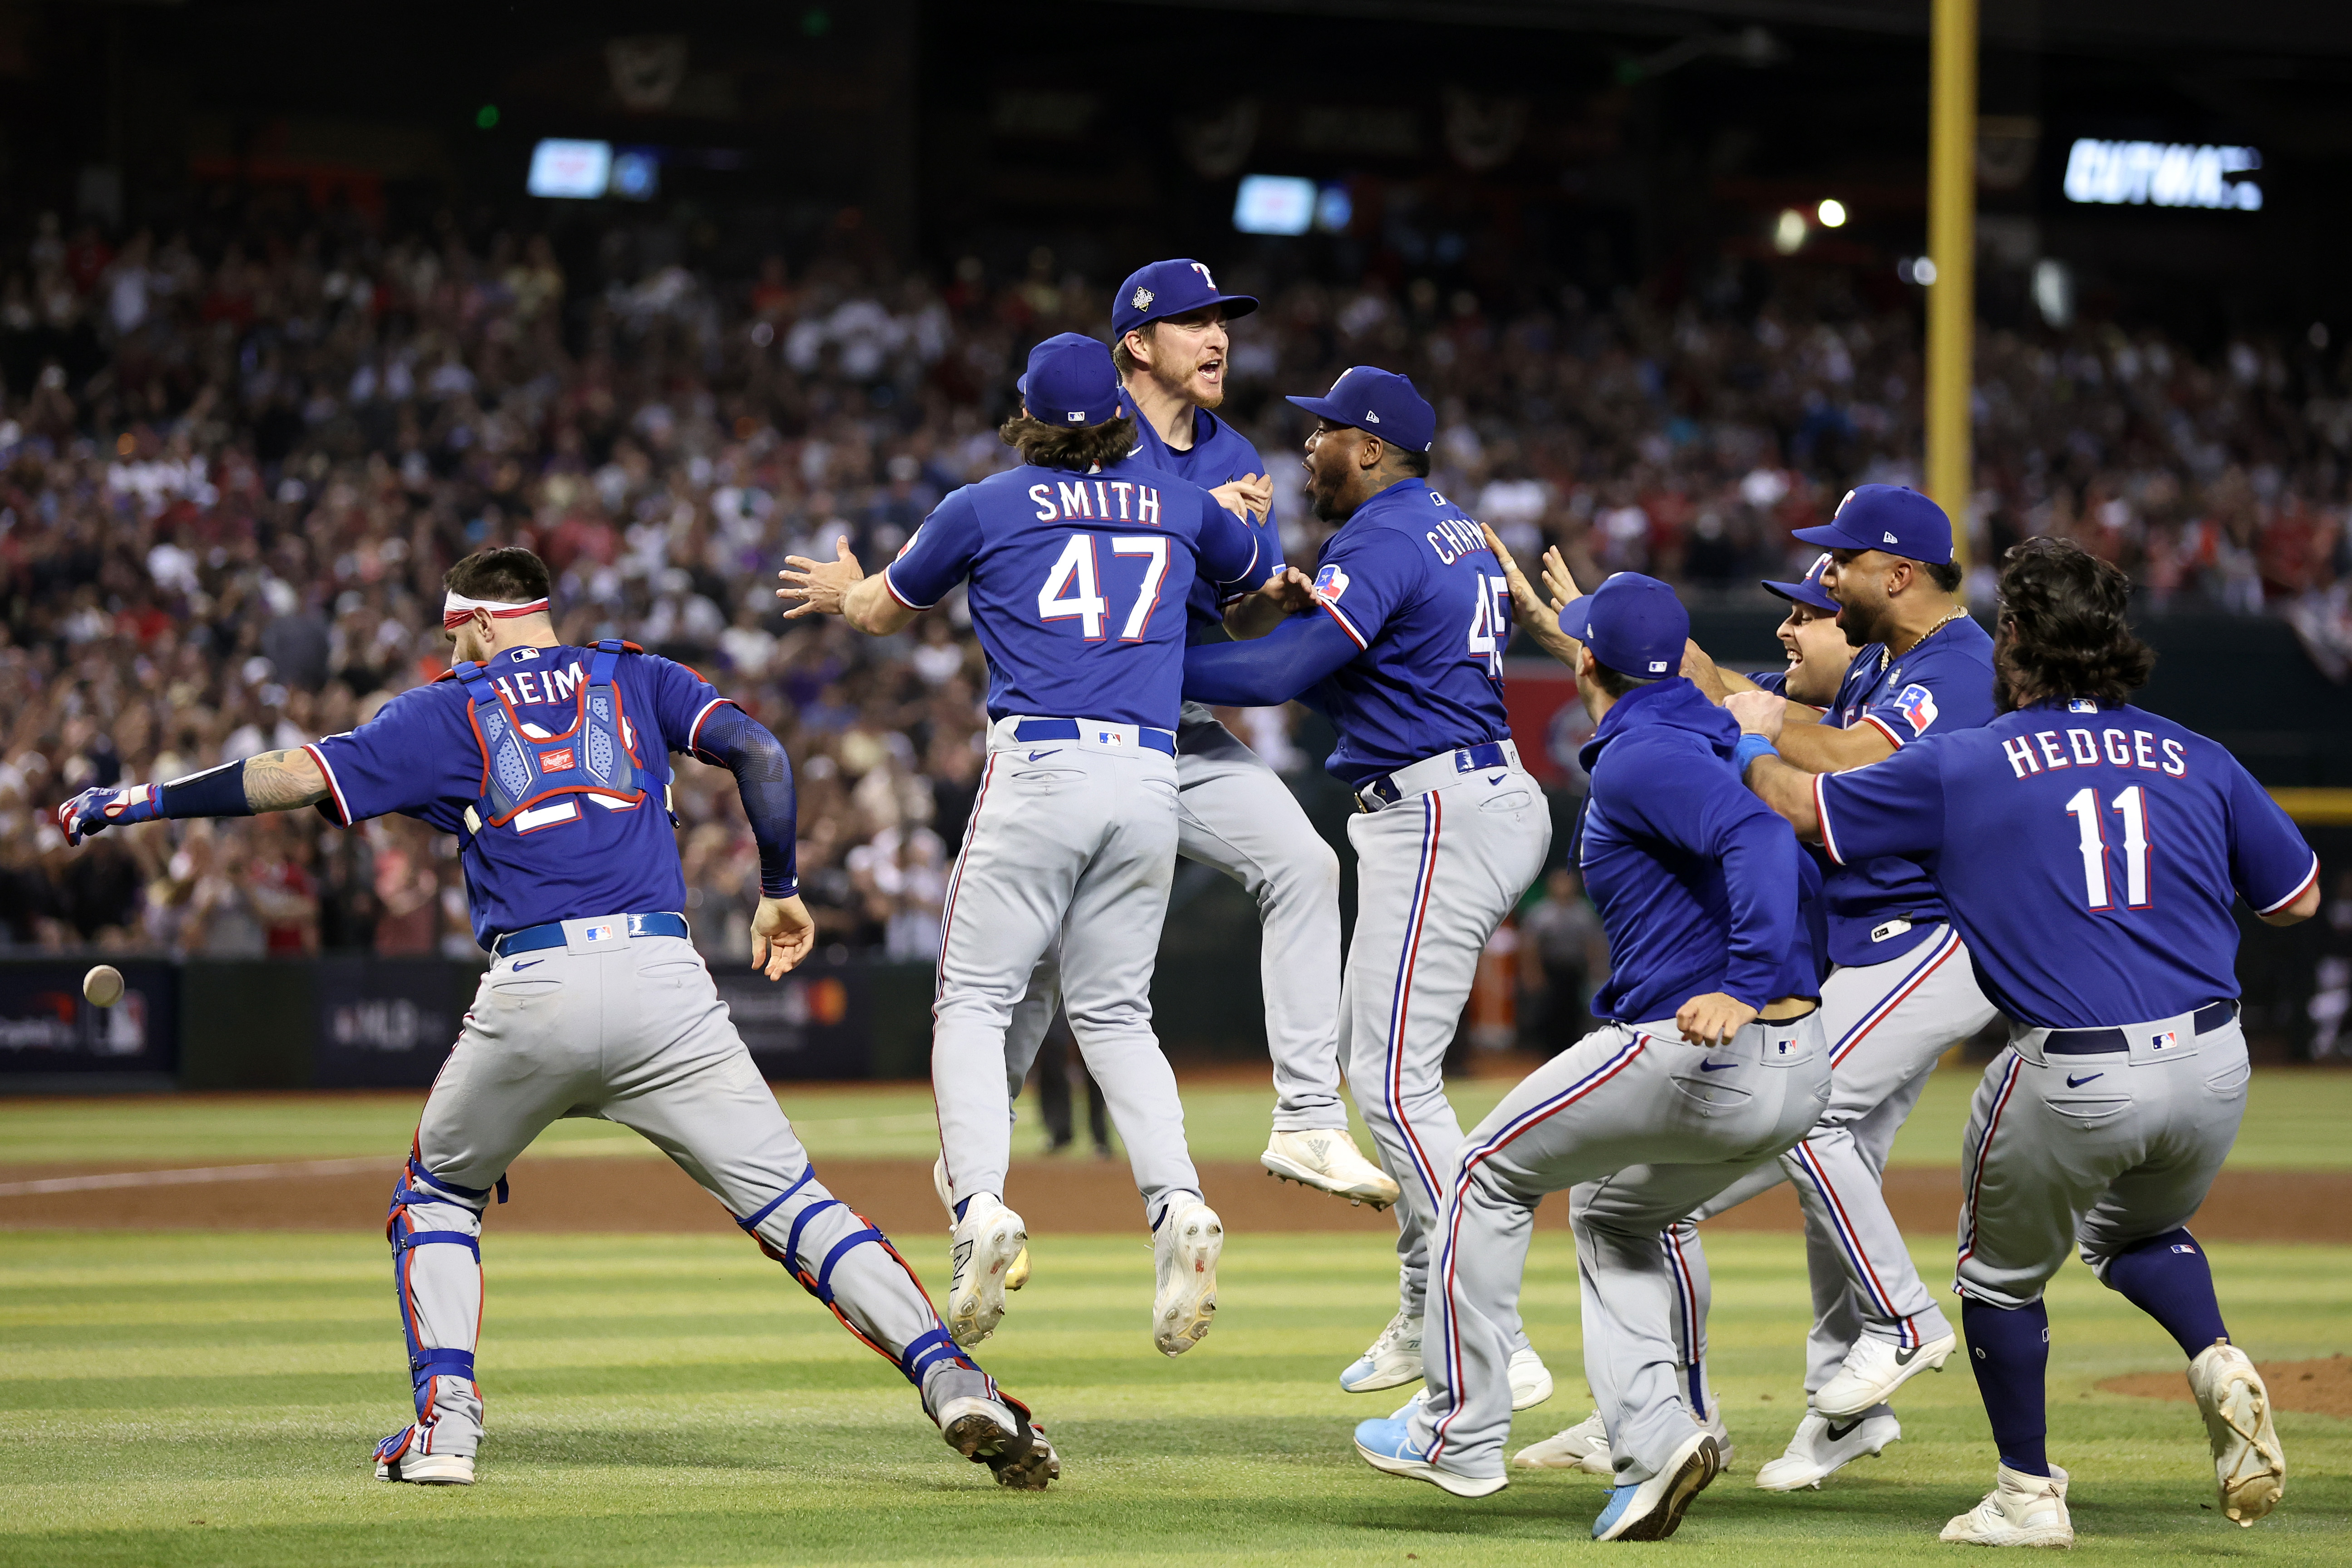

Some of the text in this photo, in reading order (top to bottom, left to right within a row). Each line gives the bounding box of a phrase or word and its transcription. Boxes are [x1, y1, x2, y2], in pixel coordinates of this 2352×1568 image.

[1191, 263, 1216, 291] T
[1133, 292, 1151, 303] WORLD
[1134, 296, 1153, 308] SERIES
[1028, 481, 1161, 526] SMITH
[1037, 534, 1170, 642] 47
[544, 753, 571, 767] Rawlings
[2002, 728, 2187, 781] HEDGES
[2066, 786, 2153, 912] 11
[1308, 1140, 1325, 1163] adidas
